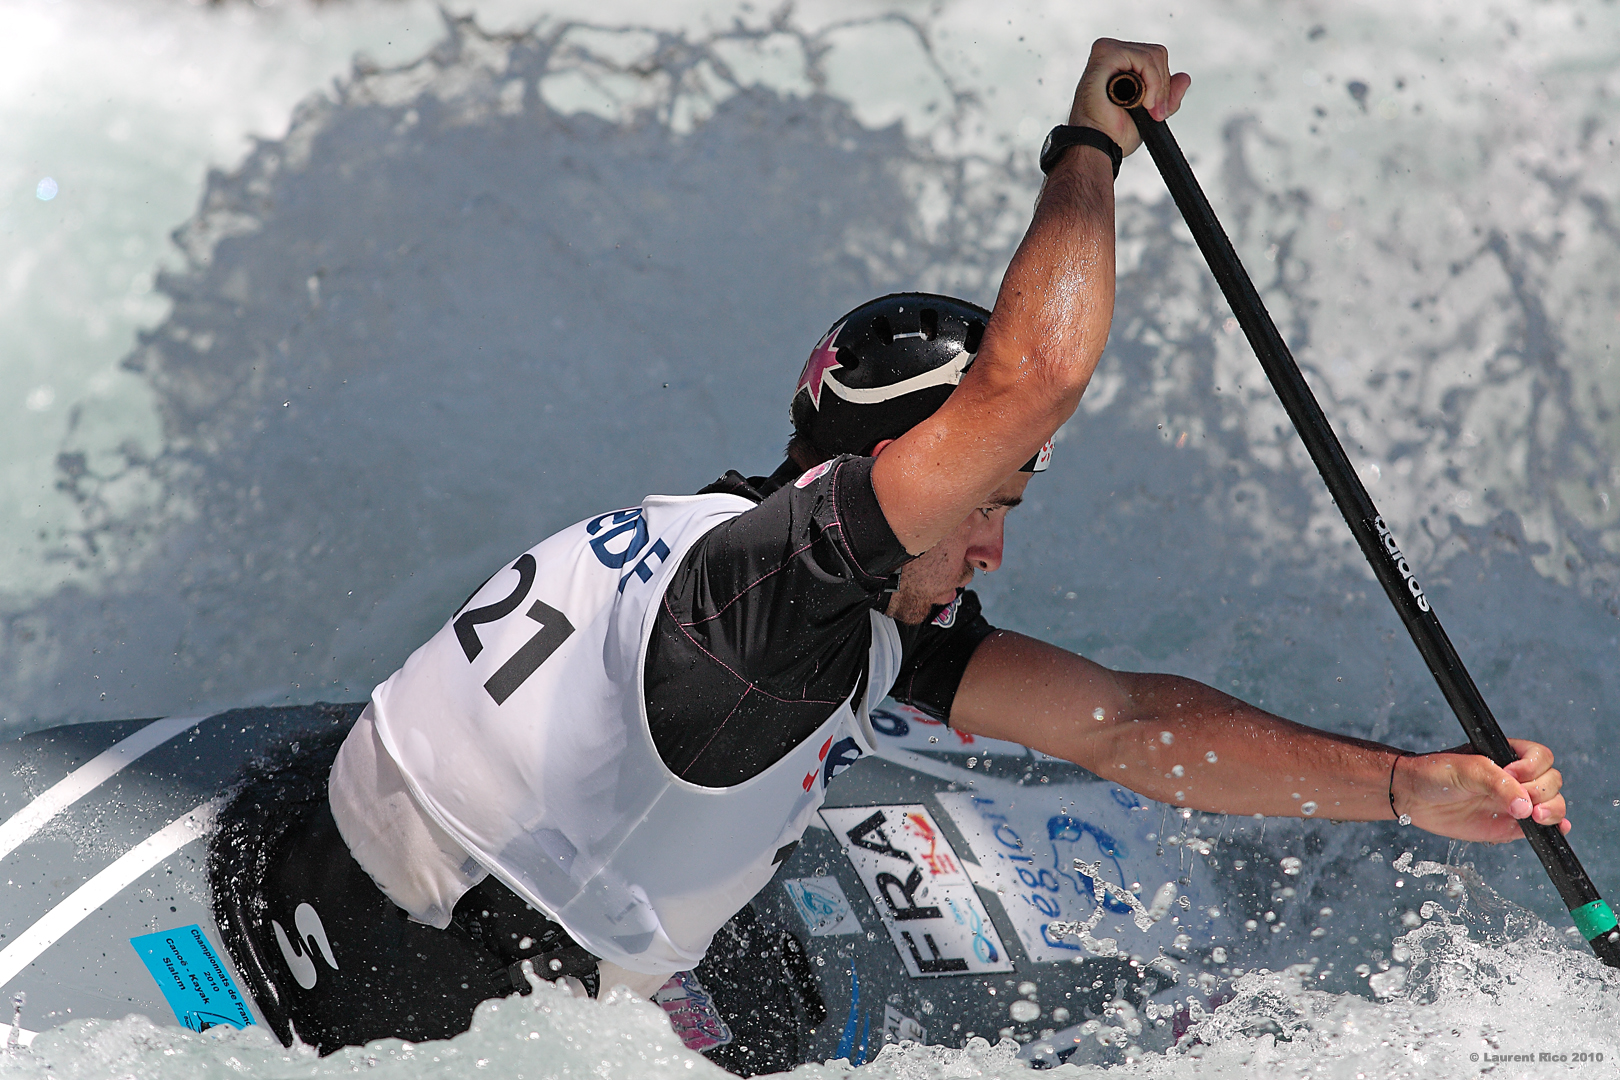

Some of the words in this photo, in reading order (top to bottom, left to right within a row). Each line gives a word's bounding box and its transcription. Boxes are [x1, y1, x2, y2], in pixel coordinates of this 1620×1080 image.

[1374, 515, 1430, 613] adidas
[452, 553, 576, 707] 21
[846, 809, 970, 974] FRA
[162, 956, 186, 991] Slalom
[165, 937, 186, 967] Canoë
[188, 973, 211, 1005] Kayak
[190, 929, 230, 988] Championnats
[227, 988, 238, 1001] de
[234, 1002, 253, 1026] Franc
[203, 971, 220, 992] 2010
